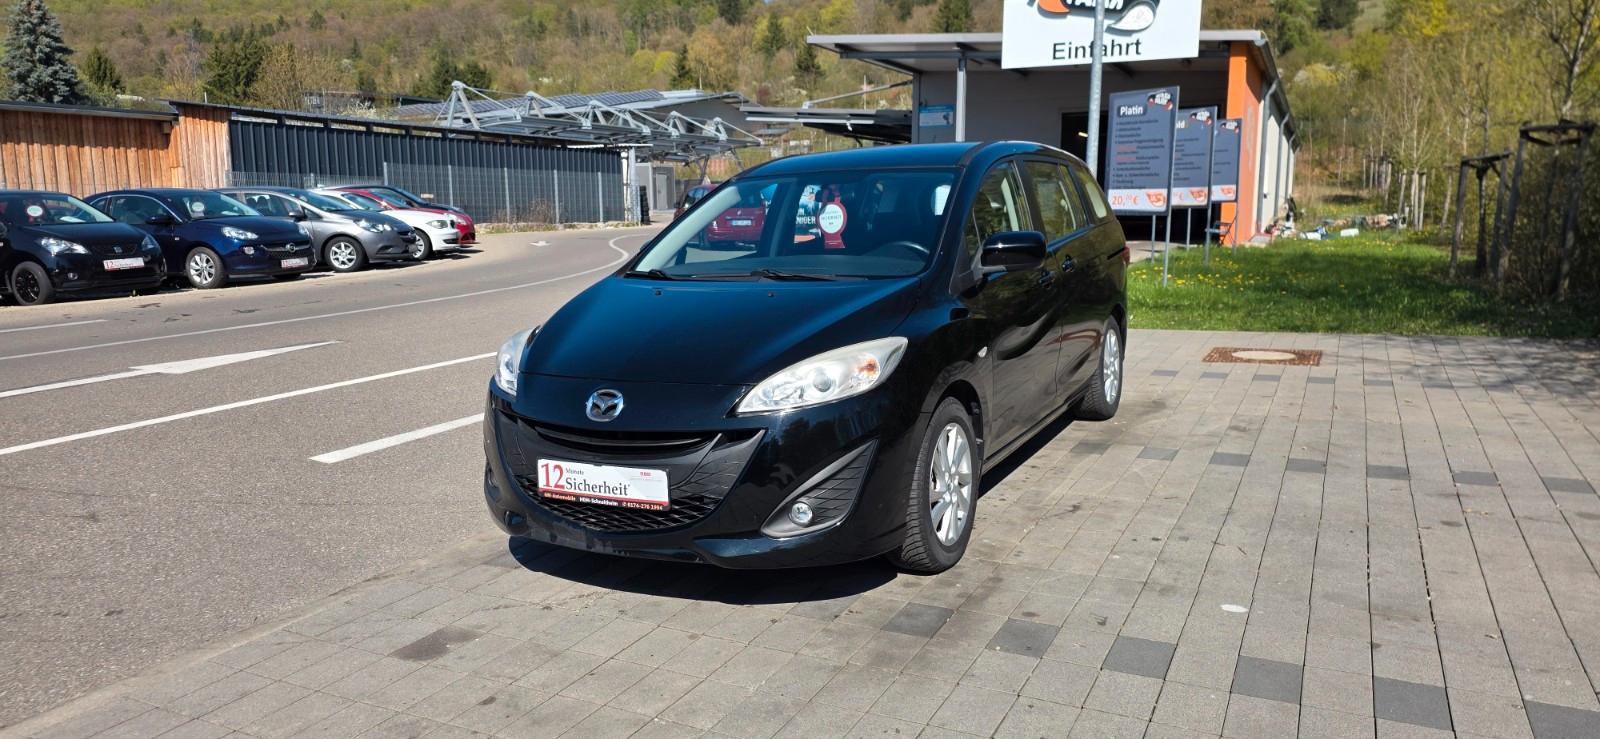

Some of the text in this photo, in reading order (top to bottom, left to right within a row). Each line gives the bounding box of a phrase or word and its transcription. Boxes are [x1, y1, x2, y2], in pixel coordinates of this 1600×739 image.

[1052, 38, 1142, 60] Einfahrt
[1119, 104, 1144, 116] Platin
[541, 463, 565, 490] 12
